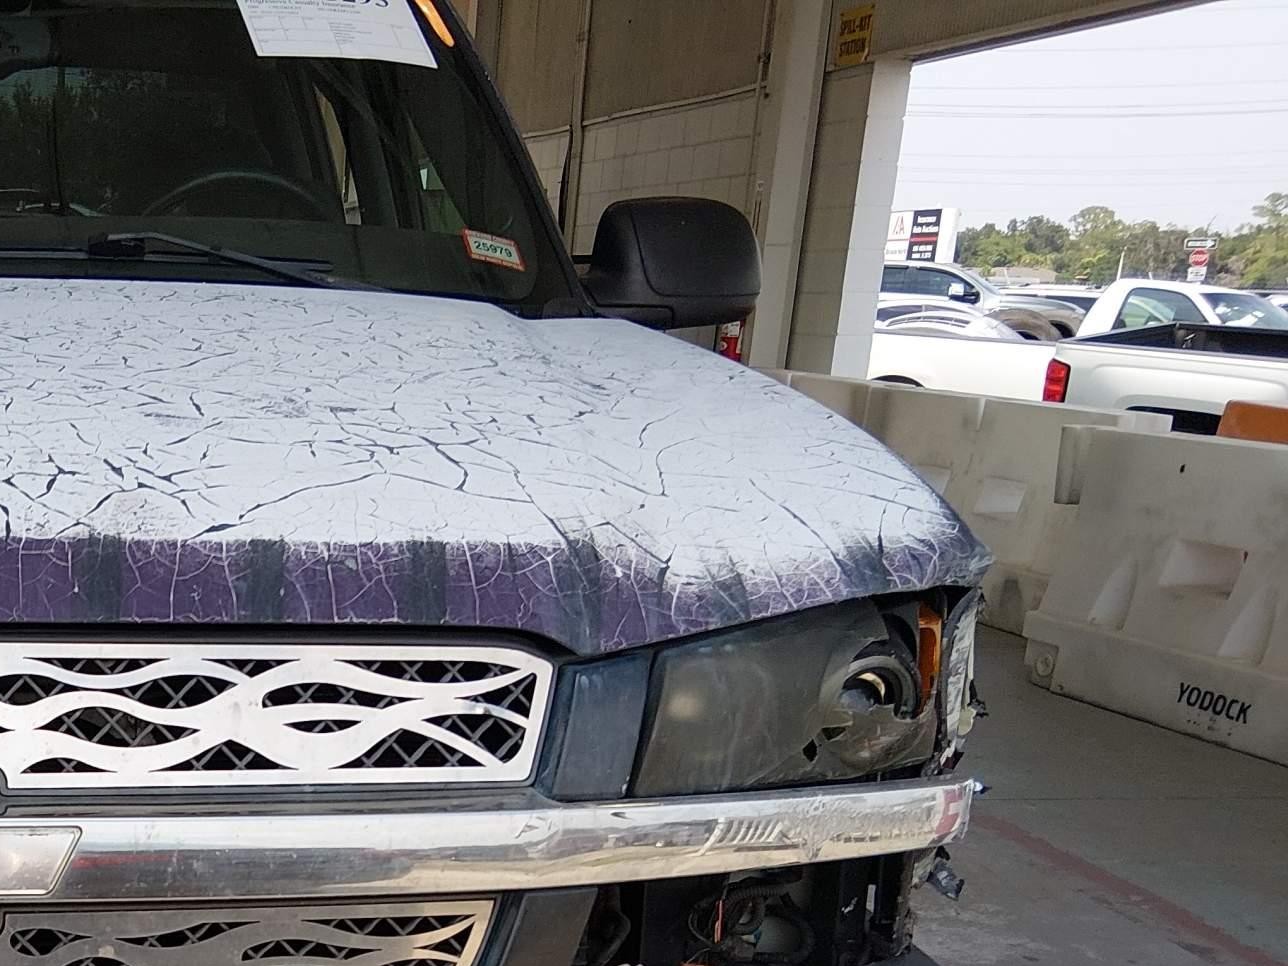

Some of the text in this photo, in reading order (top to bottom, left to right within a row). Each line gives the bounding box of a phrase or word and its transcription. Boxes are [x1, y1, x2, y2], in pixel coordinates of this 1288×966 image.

[840, 14, 873, 37] SPILL-KIT
[839, 37, 867, 57] STATION
[474, 240, 513, 258] 25979
[1177, 682, 1252, 724] YODOCK
